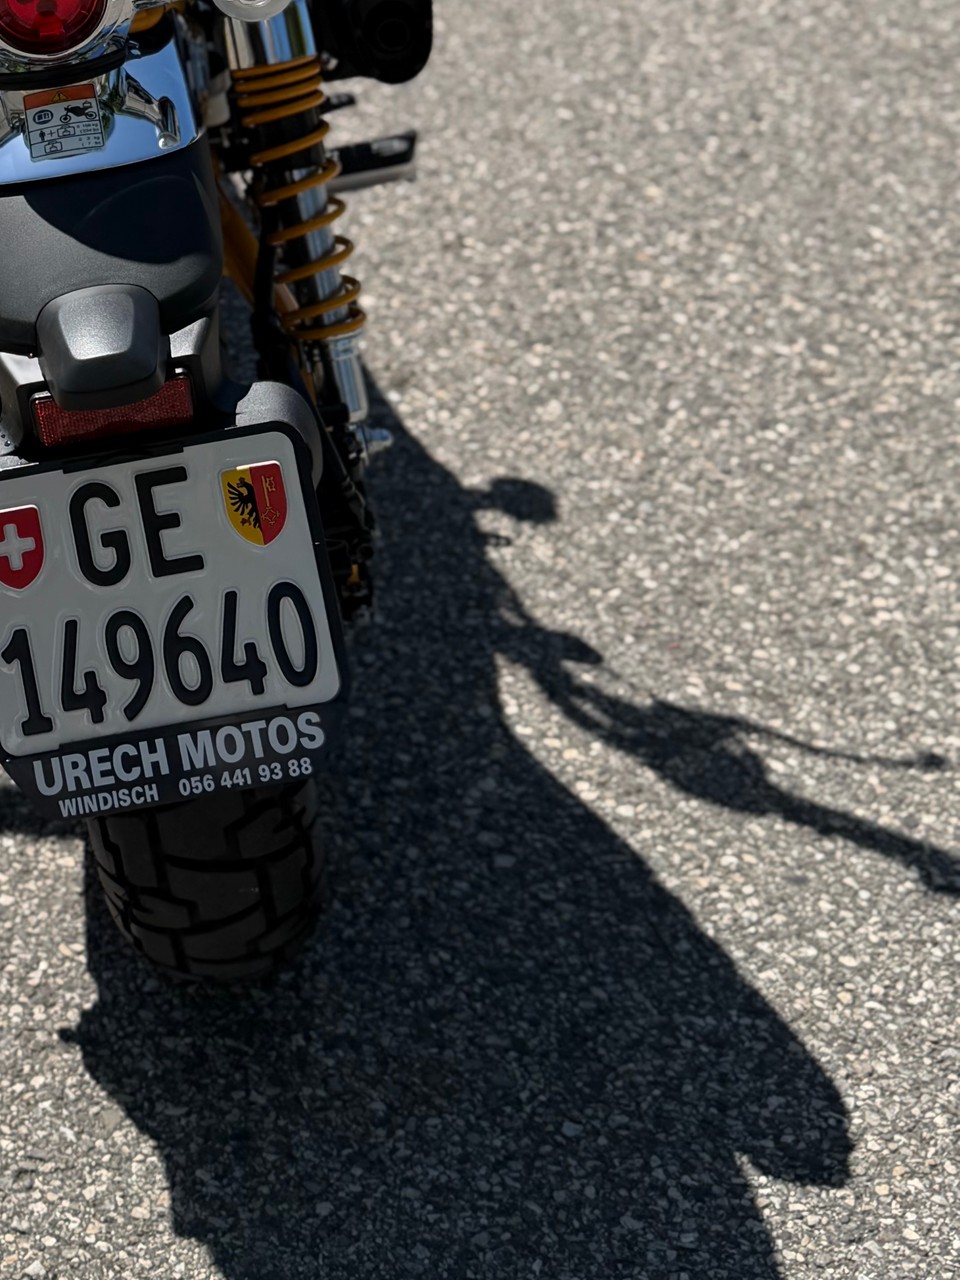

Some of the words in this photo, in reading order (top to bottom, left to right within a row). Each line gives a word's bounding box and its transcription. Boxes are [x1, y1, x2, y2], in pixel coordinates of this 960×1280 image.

[69, 466, 205, 587] GE
[1, 581, 318, 736] 149640
[33, 738, 170, 796] URECH
[177, 711, 326, 771] MOTOS
[59, 783, 159, 818] WINDISCH
[179, 774, 215, 796] 056
[220, 767, 252, 788] 441
[258, 762, 283, 782] 93
[288, 757, 313, 777] 88
